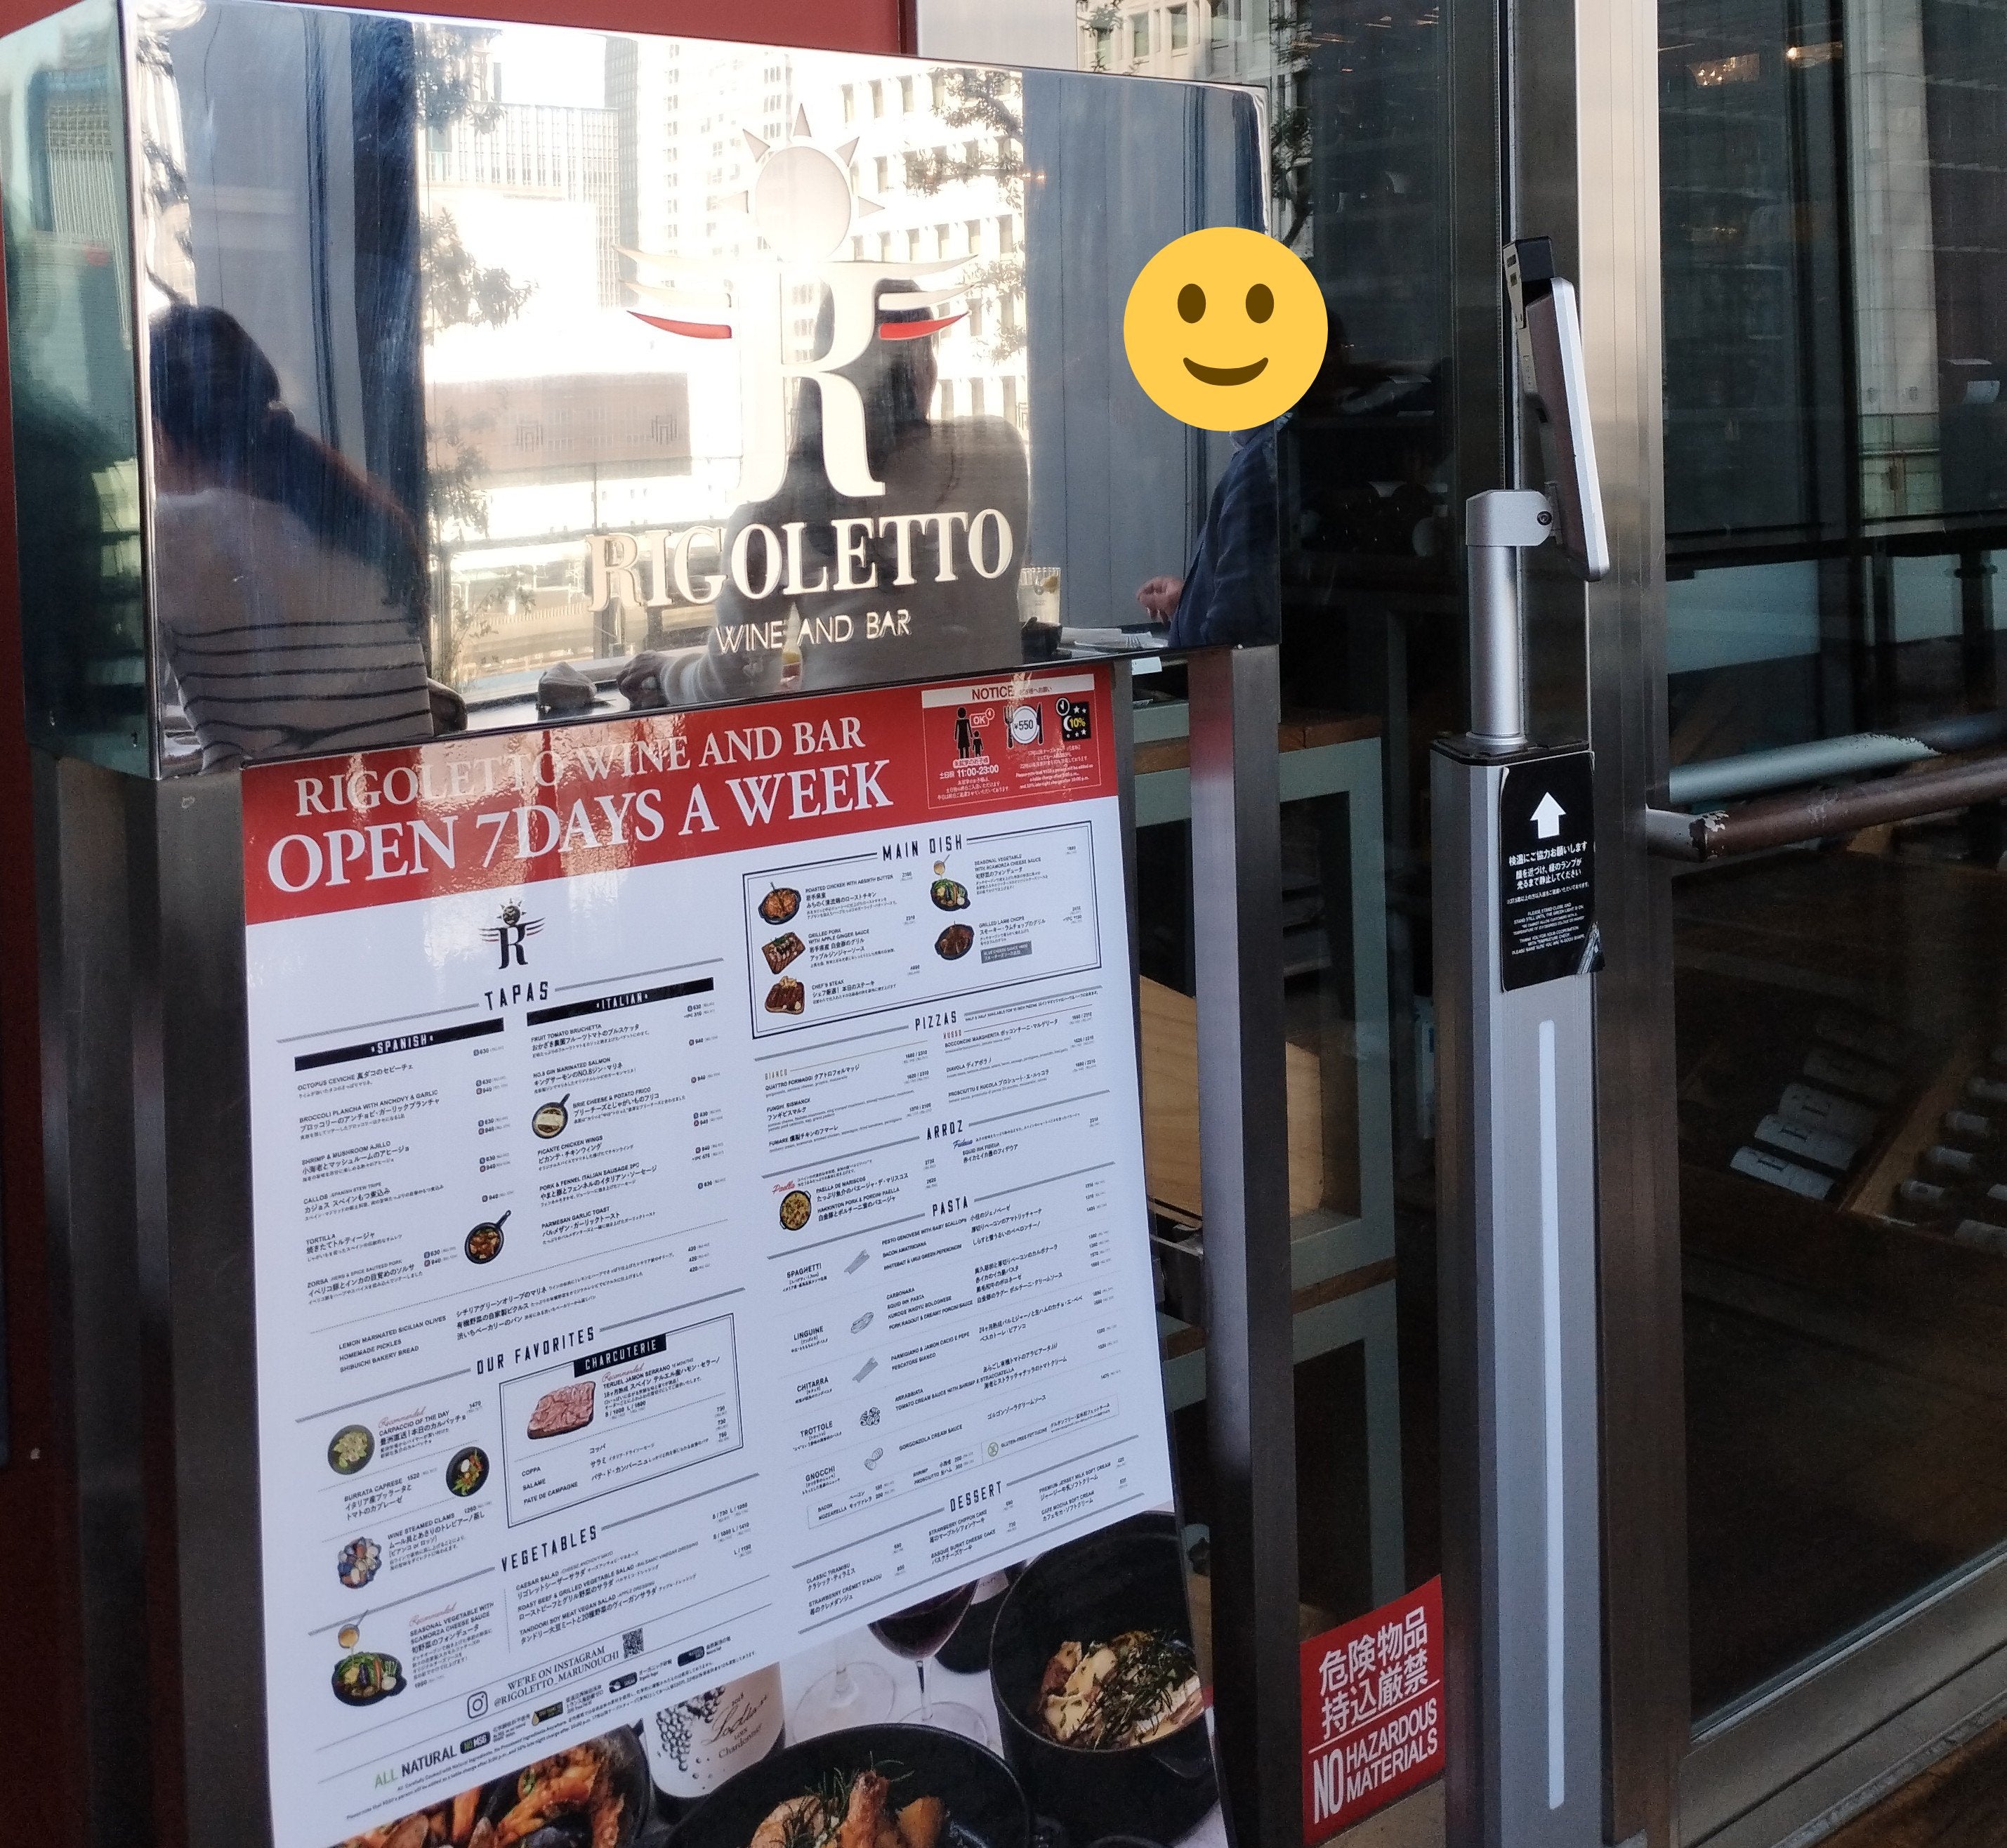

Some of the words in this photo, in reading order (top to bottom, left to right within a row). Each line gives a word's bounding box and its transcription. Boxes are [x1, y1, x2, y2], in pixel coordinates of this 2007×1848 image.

[586, 509, 1013, 612] RIGOLETTO
[716, 620, 786, 653] WINE
[797, 615, 854, 645] AND
[866, 610, 912, 638] BAR
[972, 686, 1014, 700] NOTICE
[973, 715, 985, 724] OK
[1069, 716, 1086, 728] 10%
[295, 750, 564, 817] RIGOLETTO
[577, 735, 690, 780] WINE
[699, 726, 782, 767] AND
[792, 716, 865, 755] BAR
[268, 815, 458, 893] OPEN
[475, 789, 664, 868] 7DAYS
[678, 783, 720, 836] A
[725, 759, 894, 826] WEEK
[881, 839, 919, 861] MAIN
[928, 833, 962, 854] DISH
[1509, 841, 1587, 866] 検温にご協力お願いします
[1517, 869, 1581, 890] 光るまで静止してください
[483, 980, 548, 1011] TAPAS
[600, 991, 643, 1009] ITALIAN
[914, 1009, 956, 1031] PIZZAS
[376, 1033, 427, 1054] SPANISH
[926, 1118, 963, 1141] ARROZ
[560, 1139, 584, 1150] CHICKEN
[584, 1134, 603, 1144] WINGS
[541, 1216, 571, 1229] PARMESAN
[571, 1210, 591, 1221] GARLIC
[591, 1205, 610, 1215] TOAST
[931, 1195, 968, 1217] PASTA
[305, 1233, 336, 1245] TORTILLA
[786, 1262, 822, 1278] SPAGHETTI
[338, 1339, 361, 1350] LEMON
[397, 1321, 423, 1333] SICILIAN
[423, 1314, 447, 1326] OLIVES
[793, 1325, 824, 1341] LINGUINE
[338, 1345, 375, 1361] HOMEMADE
[375, 1338, 402, 1351] PICKLES
[371, 1351, 397, 1364] BAKERY
[397, 1344, 419, 1356] BREAD
[476, 1353, 504, 1375] OUR
[514, 1325, 594, 1364] FAVORITES
[584, 1338, 657, 1370] CHARCUTERIE
[796, 1375, 829, 1393] CHITARRA
[378, 1420, 414, 1437] CARPACCIO
[799, 1420, 833, 1437] TROTTOLE
[520, 1465, 541, 1477] COPPA
[805, 1464, 835, 1482] GNOCCHI
[522, 1477, 546, 1491] SALAME
[949, 1479, 1001, 1512] DESSERT
[387, 1528, 403, 1540] WINE
[404, 1519, 433, 1535] STEAMED
[433, 1512, 455, 1524] CLAMS
[501, 1524, 597, 1572] VEGETABLES
[515, 1577, 539, 1591] CAESAR
[539, 1570, 559, 1582] SALAD
[517, 1599, 537, 1613] ROAST
[537, 1594, 552, 1605] BEEF
[558, 1582, 583, 1597] GRILLED
[582, 1570, 615, 1587] VEGETABLE
[409, 1620, 442, 1637] SEASONAL
[442, 1606, 478, 1625] VEGETABLE
[478, 1601, 494, 1612] WITH
[445, 1618, 469, 1632] CHEESE
[470, 1610, 490, 1623] SAUCE
[518, 1619, 548, 1635] TANDOORI
[561, 1608, 577, 1620] MEAT
[577, 1601, 597, 1613] VEGAN
[597, 1593, 617, 1606] SALAD
[1319, 1605, 1427, 1696] 危険物品
[493, 1650, 619, 1708] @RIGOLETTO_MARUNOUCHI
[506, 1672, 537, 1691] WE'RE
[537, 1665, 552, 1679] ON
[553, 1644, 605, 1673] INSTAGRAM
[1322, 1648, 1428, 1741] 持込厳禁
[374, 1766, 397, 1789] ALL
[402, 1745, 458, 1777] NATURAL
[1313, 1748, 1344, 1823] NO
[1346, 1697, 1437, 1774] HAZARDOUS
[1346, 1727, 1438, 1803] MATERIALS
